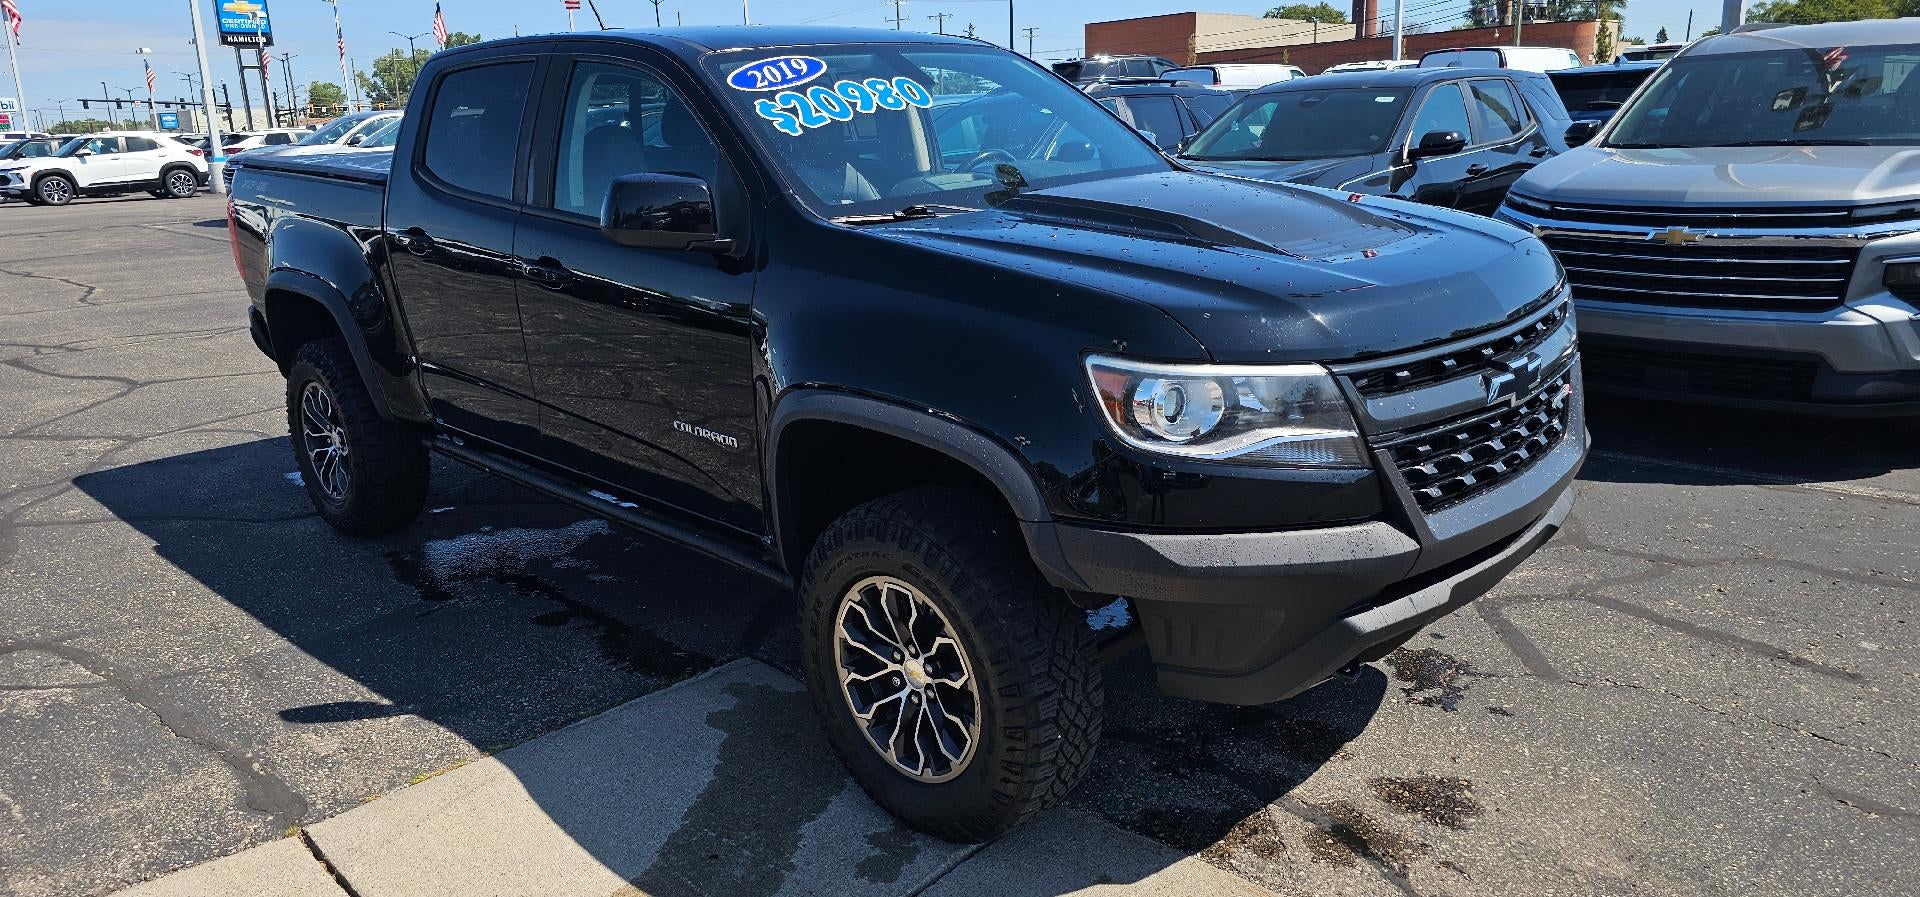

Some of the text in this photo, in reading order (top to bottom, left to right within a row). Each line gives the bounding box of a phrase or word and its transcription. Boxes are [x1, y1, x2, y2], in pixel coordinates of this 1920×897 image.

[227, 35, 267, 43] HAMILTON
[747, 58, 808, 88] 2019
[754, 76, 933, 136] $20980
[673, 419, 738, 448] COLORADO
